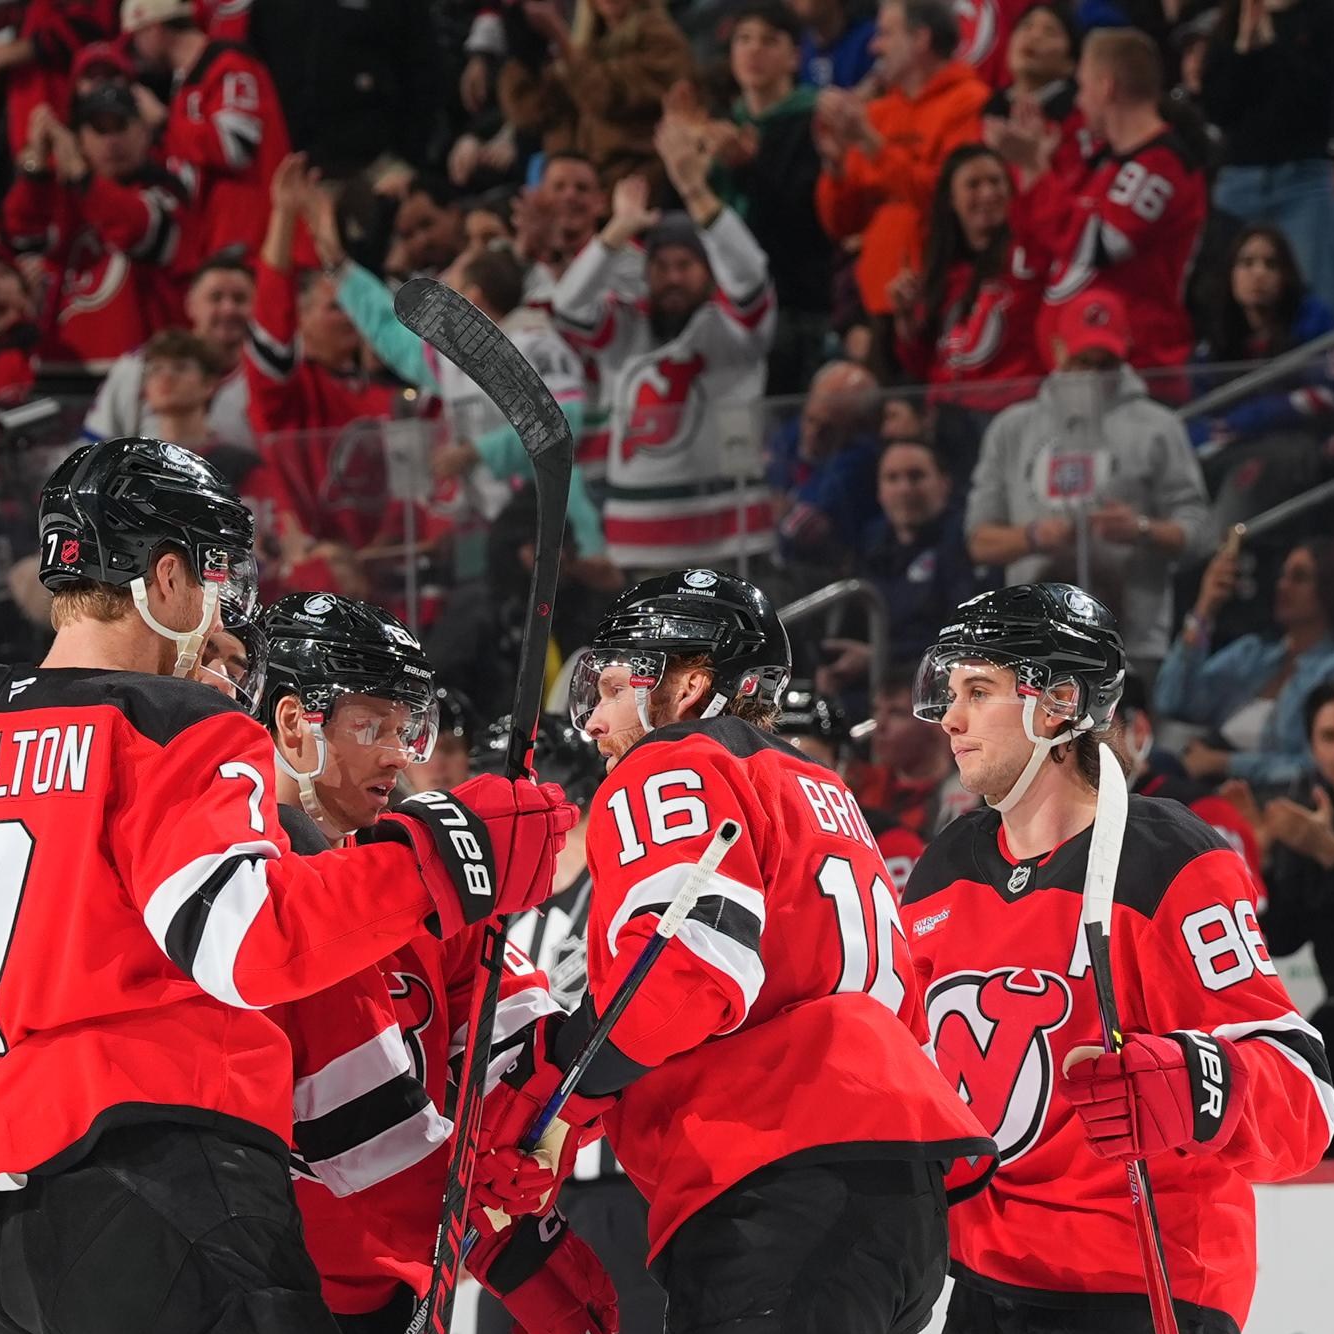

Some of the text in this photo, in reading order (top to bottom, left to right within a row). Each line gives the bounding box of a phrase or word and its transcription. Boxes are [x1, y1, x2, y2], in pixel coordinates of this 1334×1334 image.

[46, 533, 59, 566] 7
[677, 586, 716, 598] Prudential
[292, 611, 327, 625] Prudential
[403, 664, 432, 680] BAUER
[218, 760, 265, 834] 7
[607, 768, 710, 866] 16
[1180, 898, 1279, 992] 86
